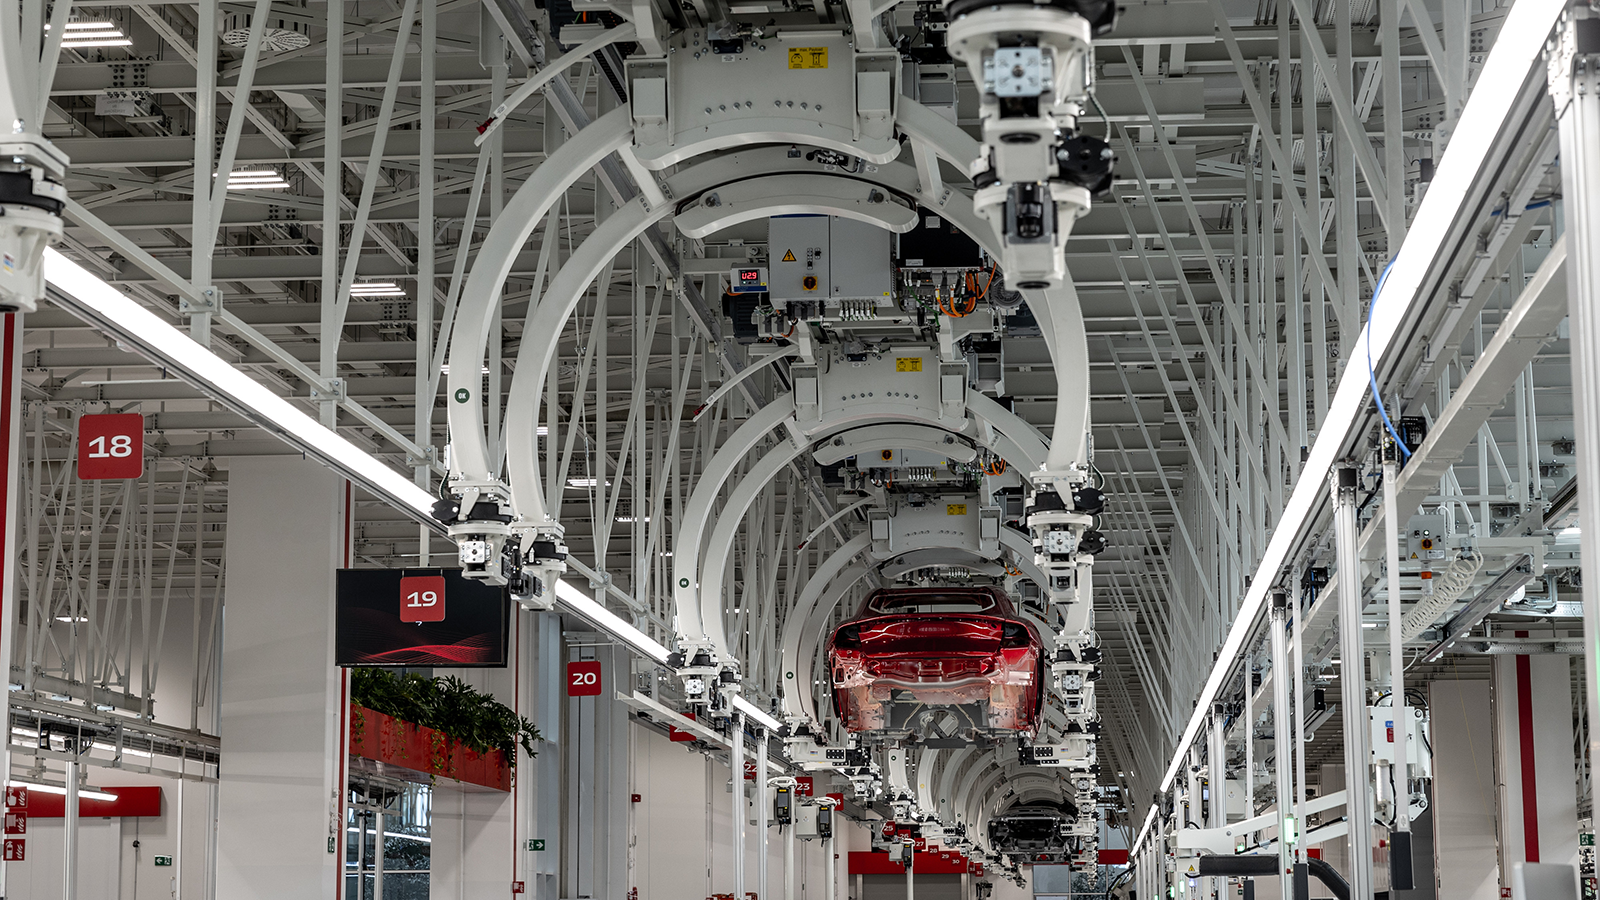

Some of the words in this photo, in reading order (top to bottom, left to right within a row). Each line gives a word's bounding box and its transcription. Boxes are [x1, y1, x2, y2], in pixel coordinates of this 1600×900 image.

[458, 392, 467, 400] OK
[88, 435, 132, 458] 18
[407, 591, 437, 607] 19
[572, 672, 597, 686] 20
[796, 782, 811, 791] 23
